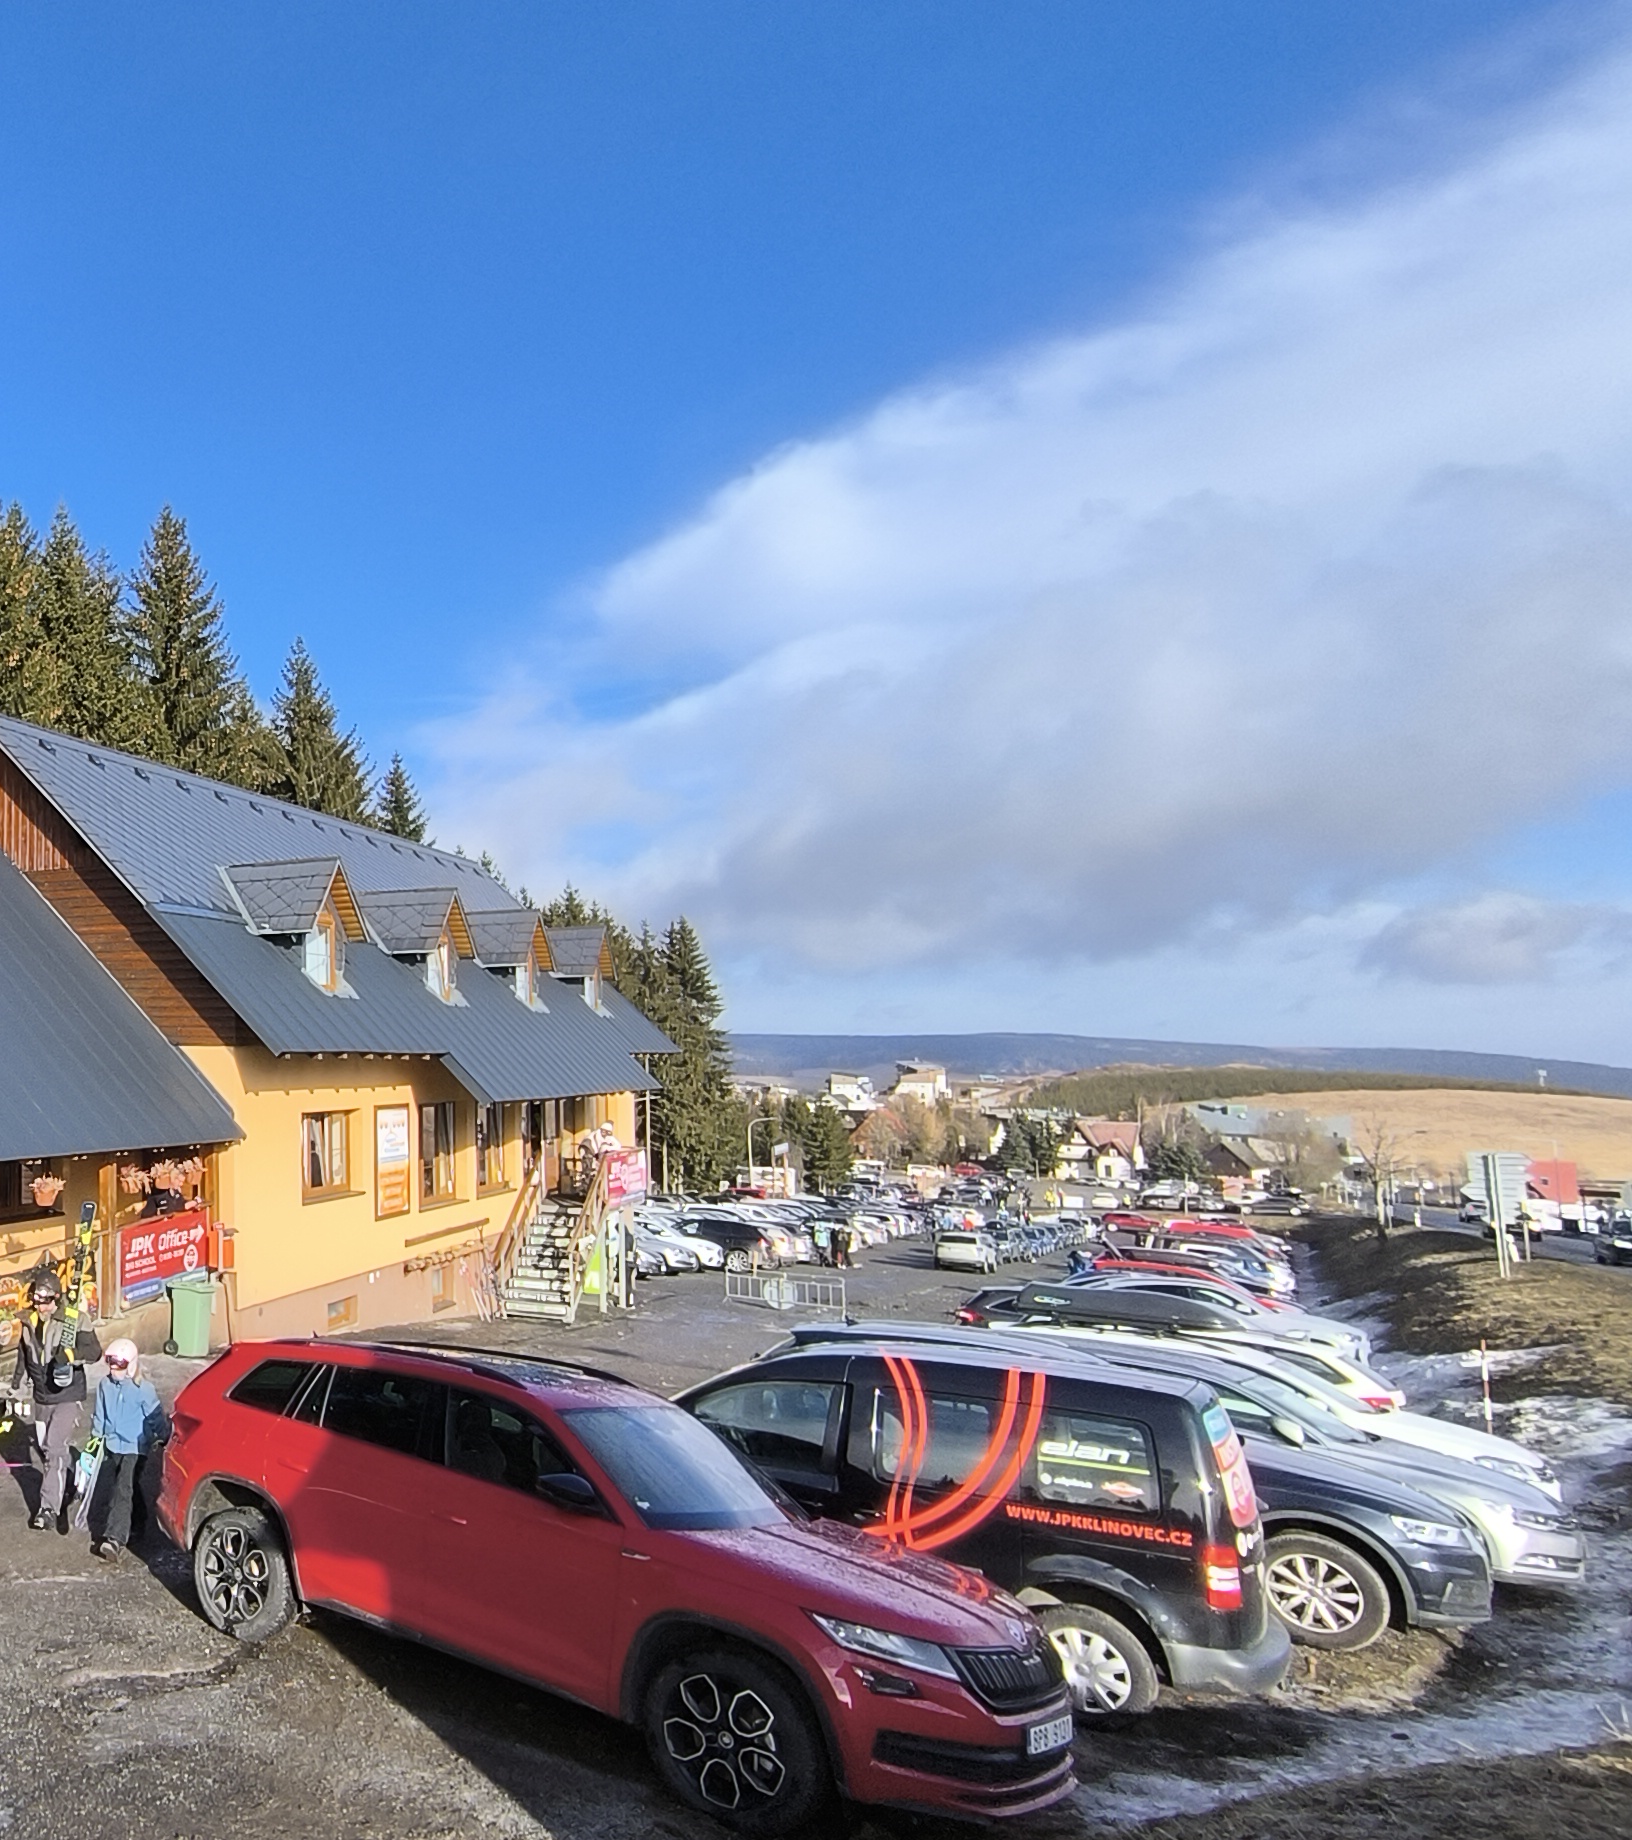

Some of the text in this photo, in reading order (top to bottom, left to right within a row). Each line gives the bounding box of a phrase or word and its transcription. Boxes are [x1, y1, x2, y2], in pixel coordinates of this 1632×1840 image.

[126, 1233, 155, 1260] JPK
[158, 1228, 188, 1251] Office
[1040, 1440, 1131, 1465] elan
[1006, 1504, 1193, 1547] WWW.JPKKLINOVEC.CZ
